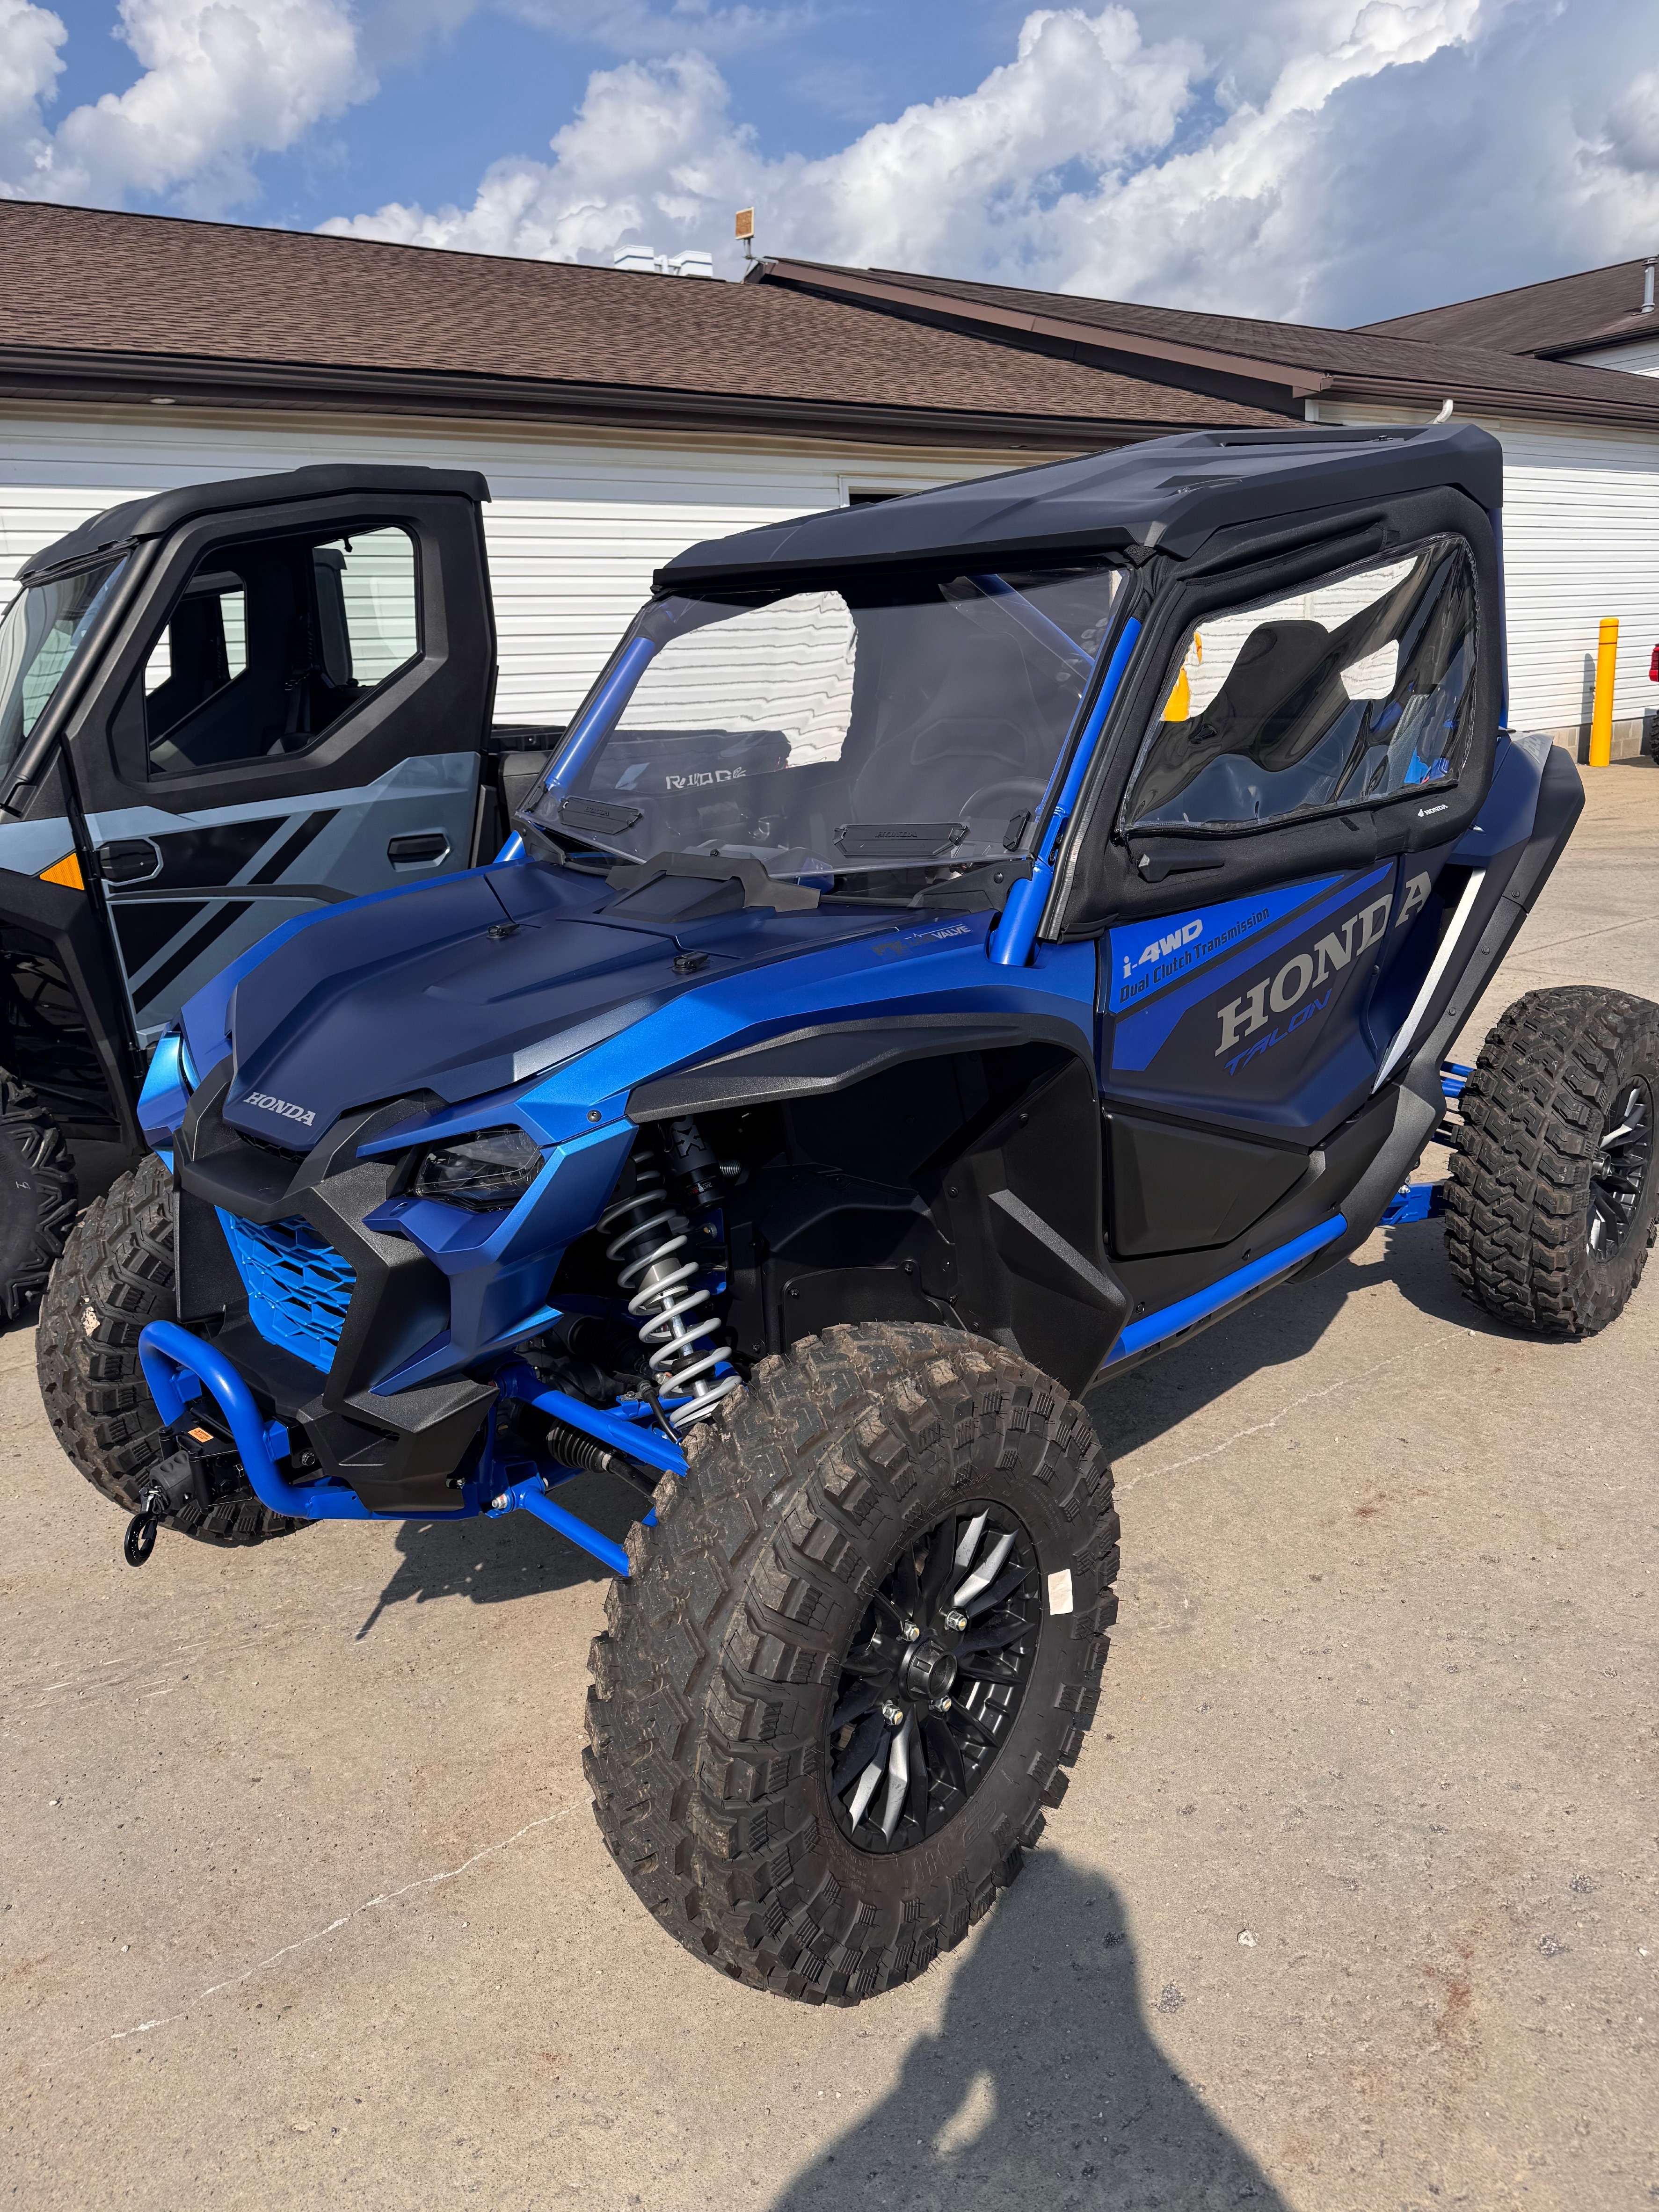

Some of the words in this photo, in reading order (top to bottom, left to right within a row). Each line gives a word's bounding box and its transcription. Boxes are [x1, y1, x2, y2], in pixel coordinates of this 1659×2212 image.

[1423, 804, 1449, 815] HONDA
[931, 926, 971, 939] VALVE
[1120, 973, 1149, 1003] Dual
[1153, 951, 1192, 984] Clutch
[1193, 908, 1269, 960] Transmission
[1123, 919, 1203, 979] i-4WD
[1215, 870, 1432, 1057] HONDA
[1224, 988, 1332, 1076] TALON
[243, 1092, 316, 1126] HONDA
